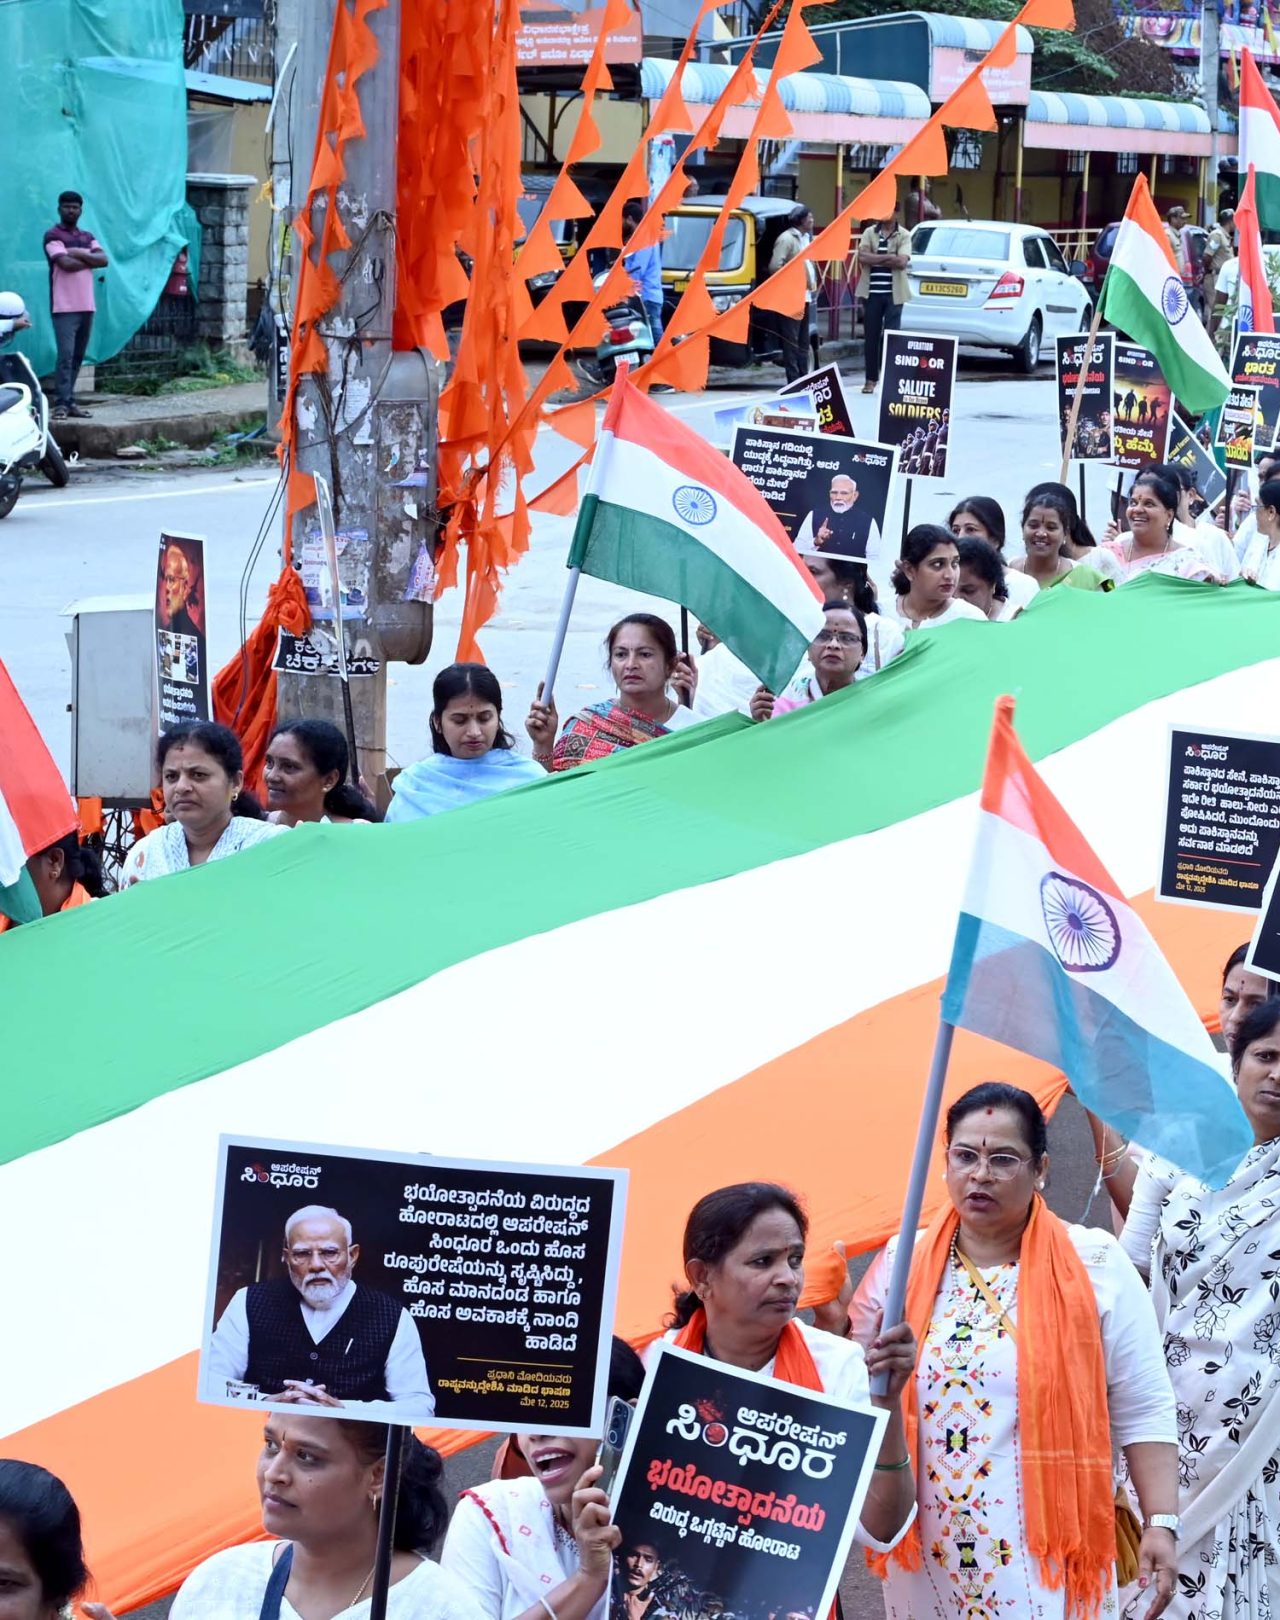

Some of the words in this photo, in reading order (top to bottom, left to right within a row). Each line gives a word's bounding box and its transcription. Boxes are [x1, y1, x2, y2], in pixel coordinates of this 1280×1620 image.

[907, 341, 934, 351] OPERATION
[1244, 361, 1276, 375] ಭಾರತ
[898, 379, 936, 397] SALUTE
[888, 402, 942, 420] SOLDIERS
[1185, 745, 1227, 761] ಸಿಂಧೂರ
[1183, 779, 1210, 791] ಸರ್ಕಾರ
[1182, 793, 1200, 804] ಇದೇ
[1179, 823, 1197, 834] ಅದು
[240, 1166, 319, 1189] ಸಿಂಧೂರ
[270, 1163, 322, 1175] ಆಪರೇಷನ್
[403, 1183, 525, 1211] ಭಯೋತ್ಪಾದನೆಯ
[530, 1193, 590, 1220] ವಿರುದ್ಧದ
[399, 1205, 499, 1235] ಹೋರಾಟದಲ್ಲಿ
[503, 1216, 588, 1236] ಆಪರೇಷನ್
[429, 1233, 492, 1253] ಸಿಂಧೂರ
[496, 1239, 539, 1256] ಒಂದು
[544, 1241, 586, 1259] ಹೊಸ
[383, 1252, 506, 1284] ರೂಪುರೇಷೆಯನ್ನು
[403, 1276, 445, 1296] ಹೊಸ
[449, 1281, 529, 1302] ಮಾನದಂಡ
[533, 1289, 581, 1306] ಹಾಗೂ
[409, 1300, 451, 1320] ಹೊಸ
[455, 1306, 531, 1332] ಅವಕಾಶಕ್ಕೆ
[533, 1311, 579, 1329] ನಾಂದಿ
[525, 1334, 577, 1352] ಹಾಡಿದೆ
[487, 1369, 515, 1381] ಪ್ರಧಾನಿ
[517, 1372, 572, 1384] ಮೋದಿಯವರು
[507, 1384, 539, 1395] ಮಾಡಿದ
[540, 1385, 571, 1397] ಭಾಷಣ
[520, 1397, 536, 1407] ಮೇ
[537, 1399, 548, 1409] 12,
[549, 1399, 570, 1409] 2025
[736, 1406, 847, 1449] ಆಪರೇಷನ್
[666, 1403, 837, 1479] ಸಿಂಧೂರ
[647, 1460, 827, 1532] ಭಯೋತ್ಪಾದನೆಯ
[649, 1502, 690, 1539] ವಿರುದ್ಧ
[690, 1516, 737, 1549] ಒಗ್ಗಟ್ಟಿನ
[738, 1528, 801, 1560] ಹೋರಾಟ
